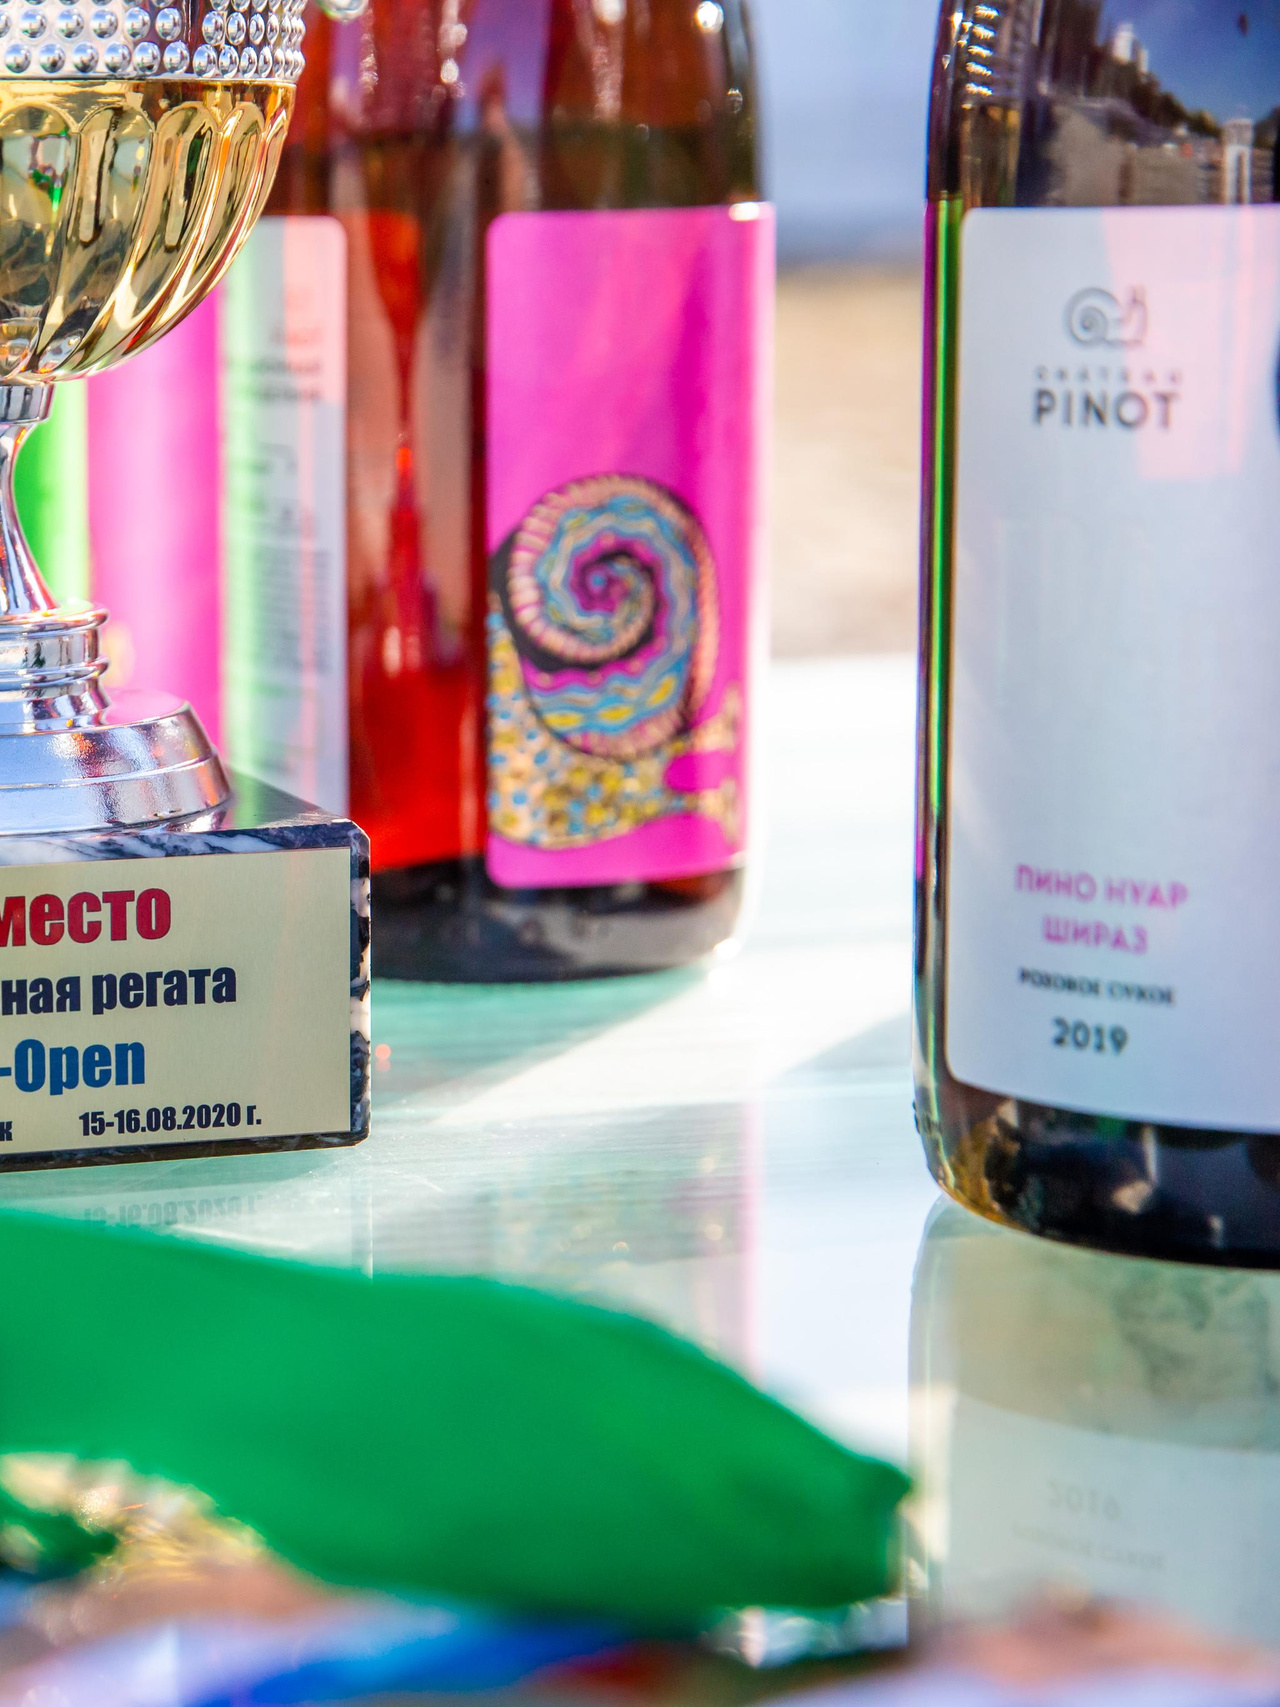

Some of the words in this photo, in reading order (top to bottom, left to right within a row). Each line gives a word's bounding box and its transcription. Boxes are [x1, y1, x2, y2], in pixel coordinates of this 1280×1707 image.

[1032, 388, 1180, 429] PINOT
[1016, 864, 1096, 901] ПИНО
[1105, 878, 1188, 909] НУАР
[1042, 916, 1147, 954] ШИРАЗ
[92, 967, 236, 1015] регата
[1051, 1017, 1129, 1056] 2019
[79, 1103, 241, 1137] 15-16.08.2020
[246, 1105, 262, 1126] г.
